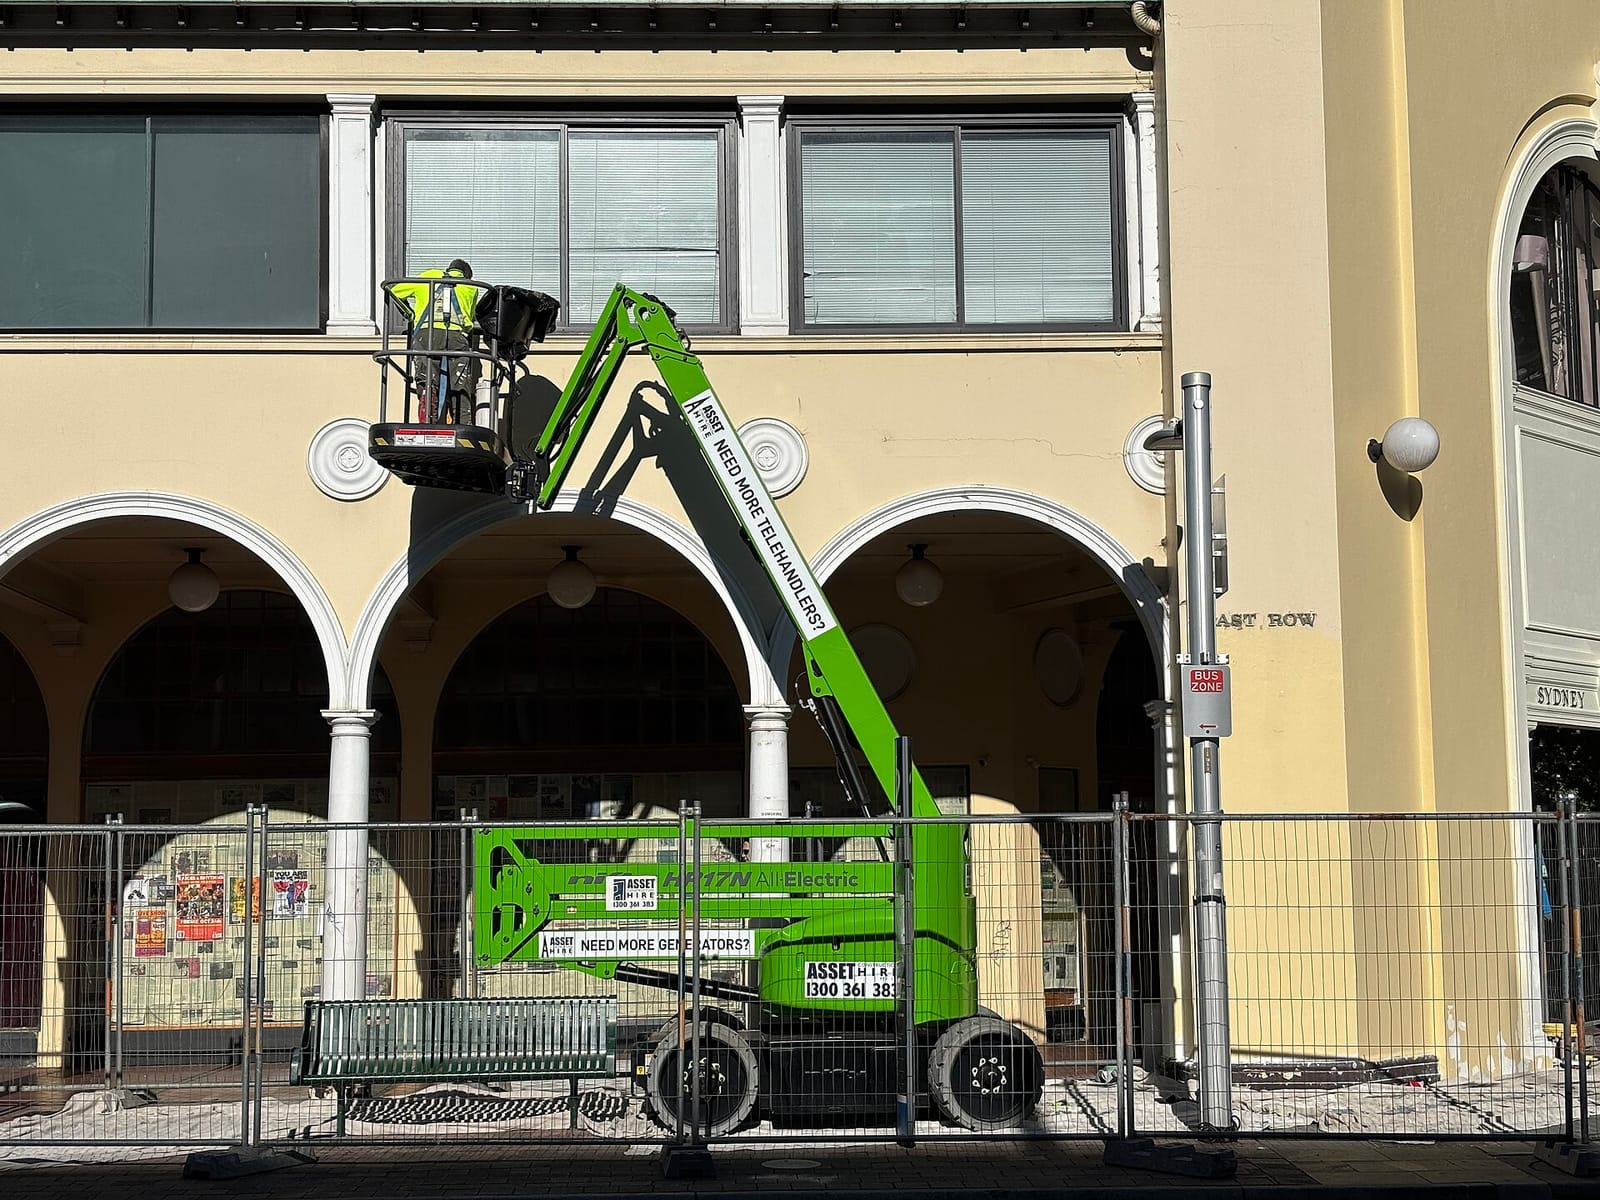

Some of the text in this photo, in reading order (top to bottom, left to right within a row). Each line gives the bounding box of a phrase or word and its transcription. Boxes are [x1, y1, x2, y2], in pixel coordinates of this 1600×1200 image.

[693, 410, 712, 439] HIRE
[702, 404, 725, 433] ASSET
[713, 438, 826, 631] NEED MORE TELEHANDLERS?
[1215, 613, 1317, 629] AST ROW
[1194, 671, 1219, 681] BUS
[1191, 682, 1222, 692] ZONE
[1537, 686, 1585, 709] SYDNEY
[627, 878, 656, 889] ASSET
[550, 936, 574, 946] ASSET
[581, 938, 750, 951] NEED MORE GEEATORS?
[807, 962, 895, 980] ASSET HIR
[807, 982, 838, 997] 1300
[843, 982, 866, 997] 361
